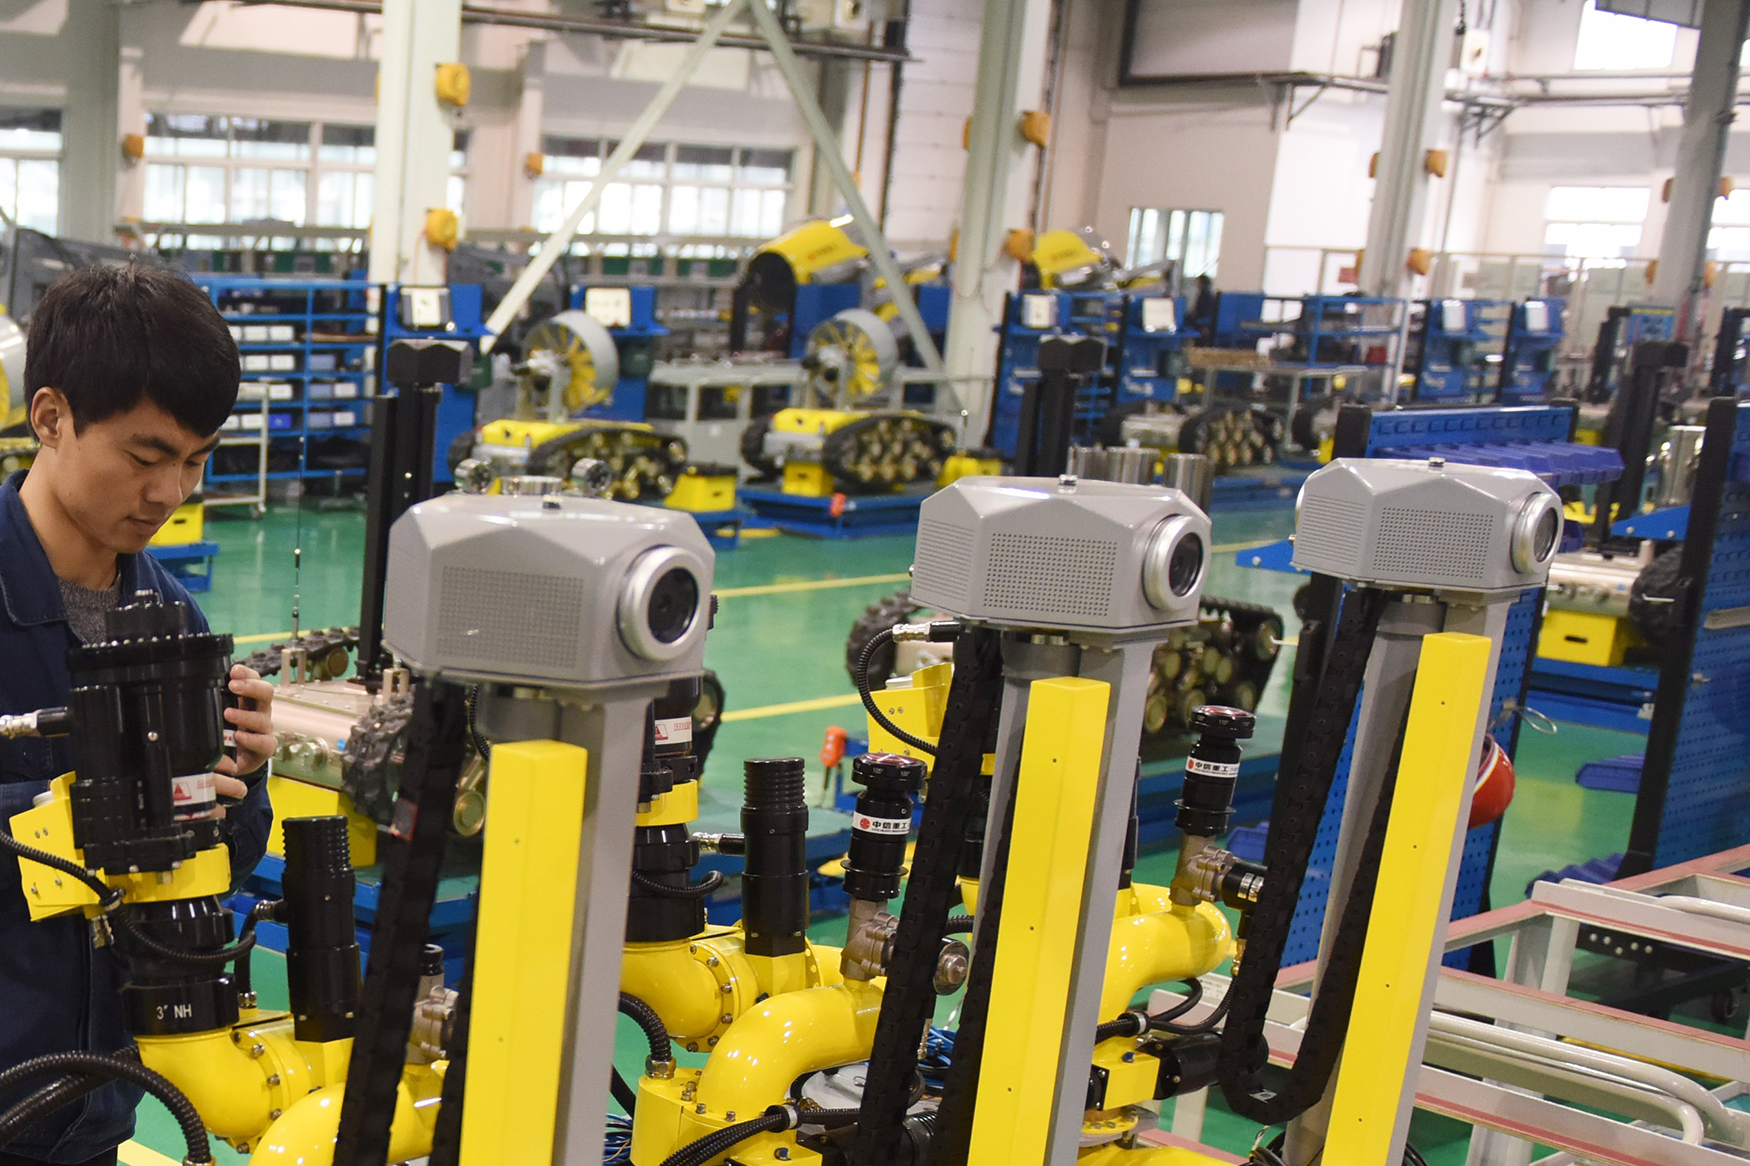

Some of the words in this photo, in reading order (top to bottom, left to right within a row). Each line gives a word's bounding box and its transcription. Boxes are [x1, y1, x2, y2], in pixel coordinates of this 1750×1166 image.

[872, 820, 908, 830] 中信重工
[174, 1003, 193, 1019] NH
